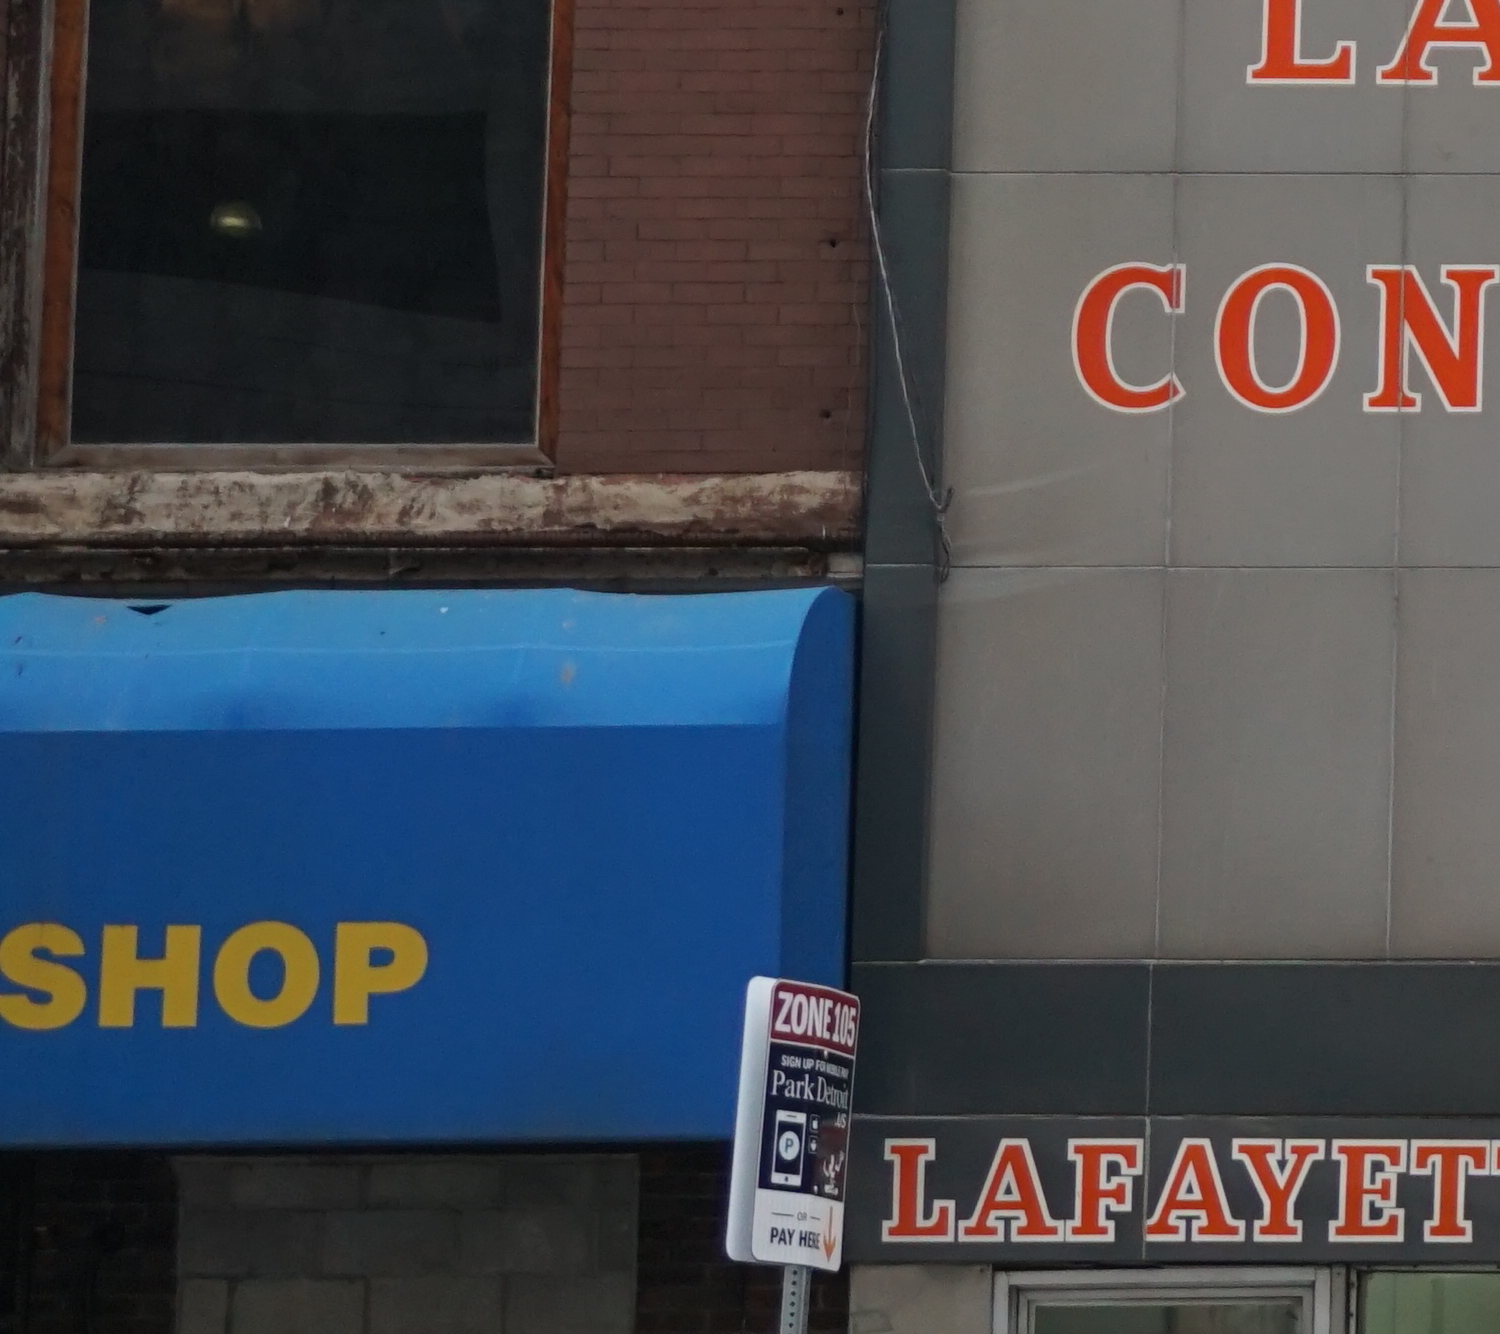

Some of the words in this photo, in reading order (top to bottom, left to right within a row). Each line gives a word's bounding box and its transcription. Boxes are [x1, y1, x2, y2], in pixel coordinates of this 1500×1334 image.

[0, 920, 428, 1031] SHOP
[774, 990, 834, 1041] ZONE
[832, 1000, 857, 1048] 105
[781, 1054, 802, 1069] SIGN
[802, 1058, 814, 1070] UP
[769, 1069, 815, 1101] Park
[816, 1075, 849, 1110] Detroit
[797, 1211, 807, 1221] OR
[770, 1226, 796, 1247] PAY
[798, 1230, 821, 1250] HERE
